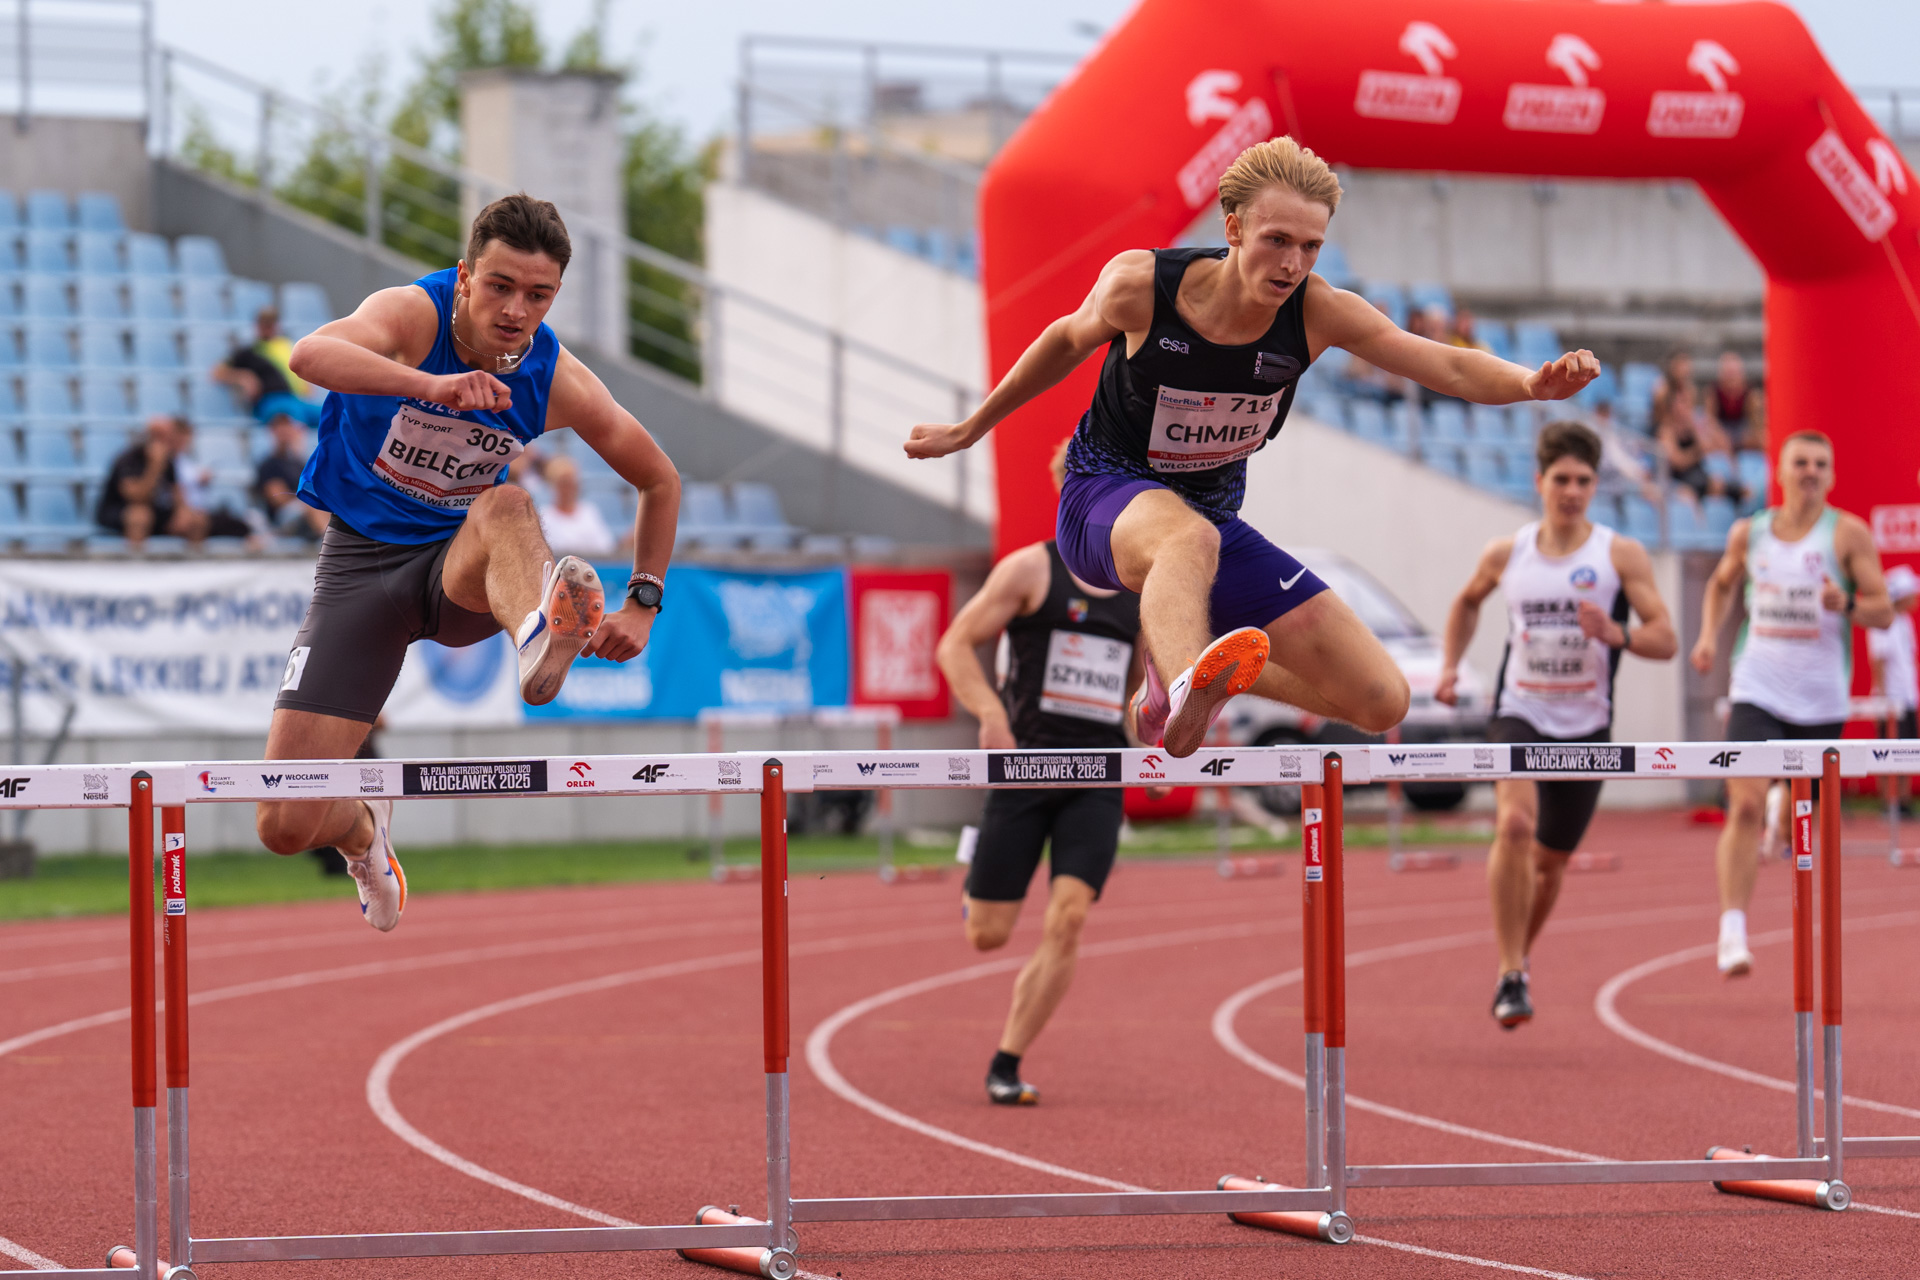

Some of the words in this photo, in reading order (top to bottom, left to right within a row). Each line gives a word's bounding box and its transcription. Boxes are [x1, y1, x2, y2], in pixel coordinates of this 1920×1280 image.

[1160, 393, 1203, 407] InterRisk
[1230, 397, 1274, 414] 718
[401, 414, 420, 425] TVP
[421, 422, 454, 433] SPORT
[466, 428, 514, 456] 305
[1165, 423, 1262, 444] CHMIEL
[388, 438, 498, 480] BIELECKI
[1160, 457, 1229, 470] WŁOCŁAWEK
[382, 474, 450, 507] WŁOCŁAWEK
[1029, 756, 1071, 764] MISTRZOSTWA
[1072, 756, 1094, 764] POLSKI
[1200, 758, 1235, 776] 4F
[1525, 754, 1592, 770] WŁOCŁAWEK
[1593, 754, 1621, 770] 2025
[448, 765, 493, 775] MISTRZOSTWA
[494, 765, 517, 774] POLSKI
[518, 764, 531, 773] U20
[632, 764, 670, 783] 4F
[1003, 764, 1075, 780] WŁOCŁAWEK
[1077, 764, 1106, 779] 2025
[420, 774, 497, 791] WŁOCŁAWEK
[500, 773, 531, 789] 2025
[566, 780, 595, 788] ORLEN
[171, 854, 183, 894] polanik
